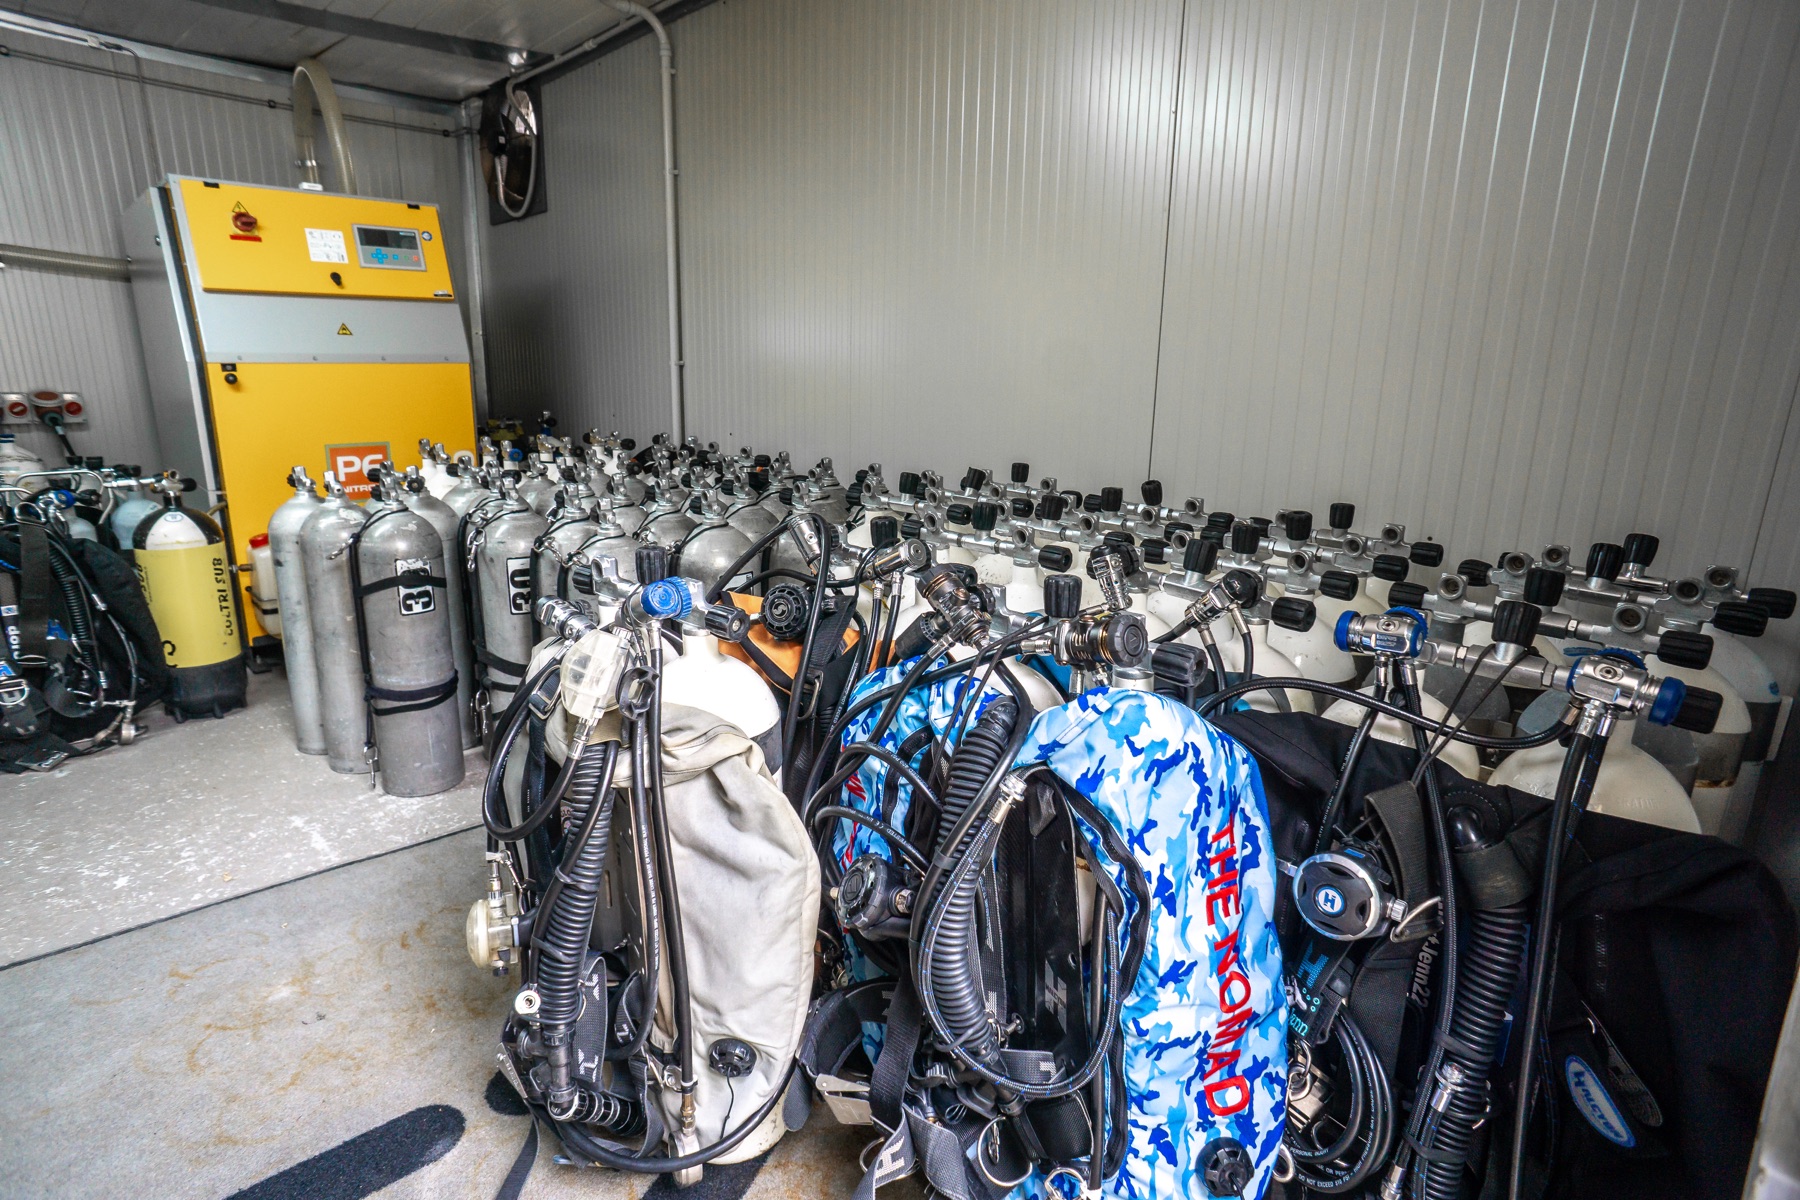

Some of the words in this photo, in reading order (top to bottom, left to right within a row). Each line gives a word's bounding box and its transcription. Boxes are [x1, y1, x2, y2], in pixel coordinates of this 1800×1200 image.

[212, 557, 228, 585] SUB
[1206, 813, 1241, 926] THE
[1203, 930, 1252, 1116] NOMAD
[1289, 1147, 1313, 1157] PERSONAL
[1306, 1177, 1316, 1187] NOT
